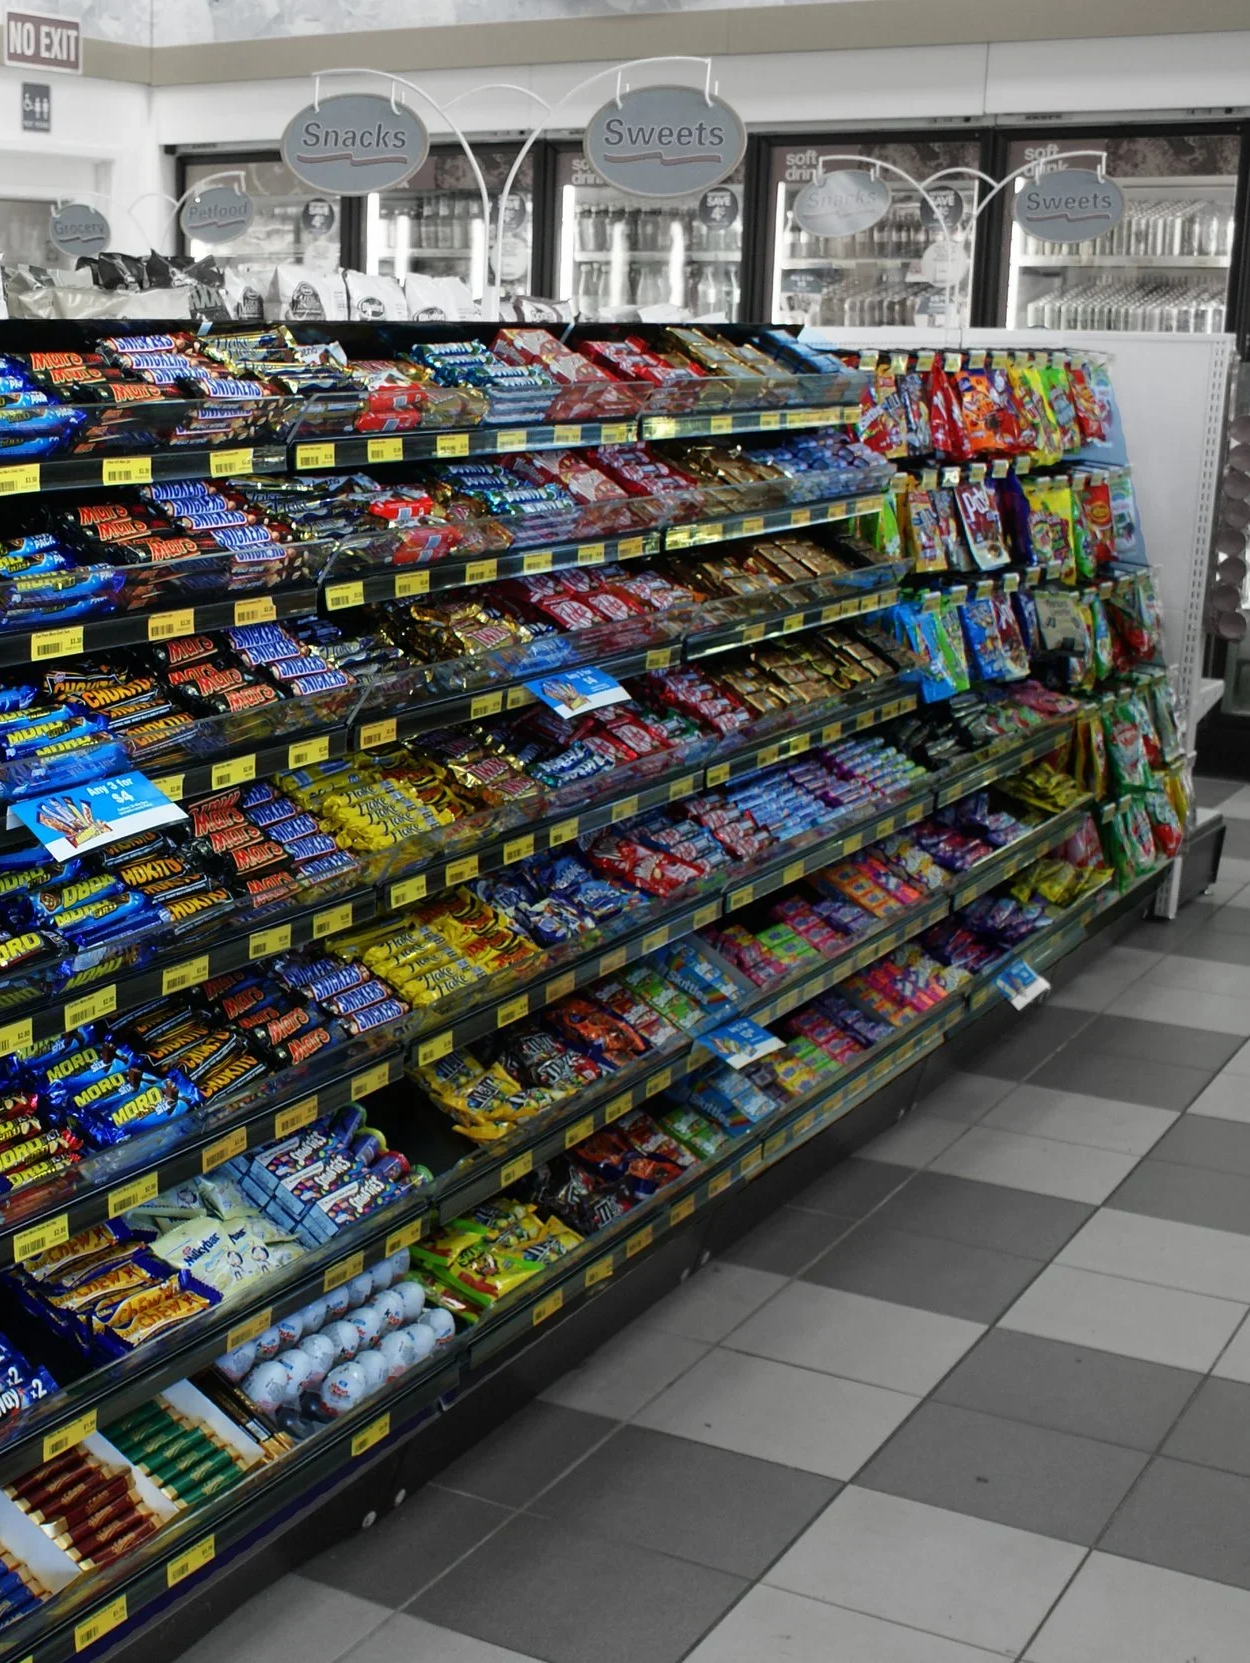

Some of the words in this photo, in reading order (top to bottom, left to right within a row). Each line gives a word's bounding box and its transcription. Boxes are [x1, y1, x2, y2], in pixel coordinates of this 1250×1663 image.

[8, 20, 36, 57] NO
[40, 26, 78, 62] EXIT
[302, 122, 407, 150] Snacks
[604, 119, 725, 147] Sweets
[786, 151, 818, 166] soft
[188, 201, 249, 221] Petfood
[1026, 192, 1113, 212] Sweets
[52, 218, 105, 239] Grocery
[152, 481, 208, 500] SNICKERS
[79, 505, 128, 526] Mars
[98, 520, 148, 541] Mars
[211, 526, 272, 547] SNICKERS
[151, 537, 198, 561] Mars
[169, 635, 215, 663] Mars
[299, 669, 348, 694] SNICKERS
[470, 758, 510, 784] TWIX
[86, 783, 107, 798] Any
[108, 780, 118, 793] 3
[119, 777, 134, 790] for
[112, 790, 136, 804] $4
[346, 785, 378, 804] Flake
[382, 812, 415, 834] Flake
[392, 823, 424, 843] Flake
[210, 825, 261, 854] Mars
[233, 840, 284, 871] Mars
[436, 974, 470, 997] Flake
[339, 983, 387, 1014] SNICKERS
[356, 1001, 403, 1031] SNICKERS
[47, 1047, 99, 1082] MORO
[91, 1060, 107, 1074] stix
[74, 1072, 126, 1108] MORO
[111, 1086, 163, 1128] MORO
[289, 1130, 328, 1162] Smarties
[313, 1157, 352, 1190] Smarties
[348, 1175, 386, 1212] Smarties
[29, 1378, 49, 1401] x2
